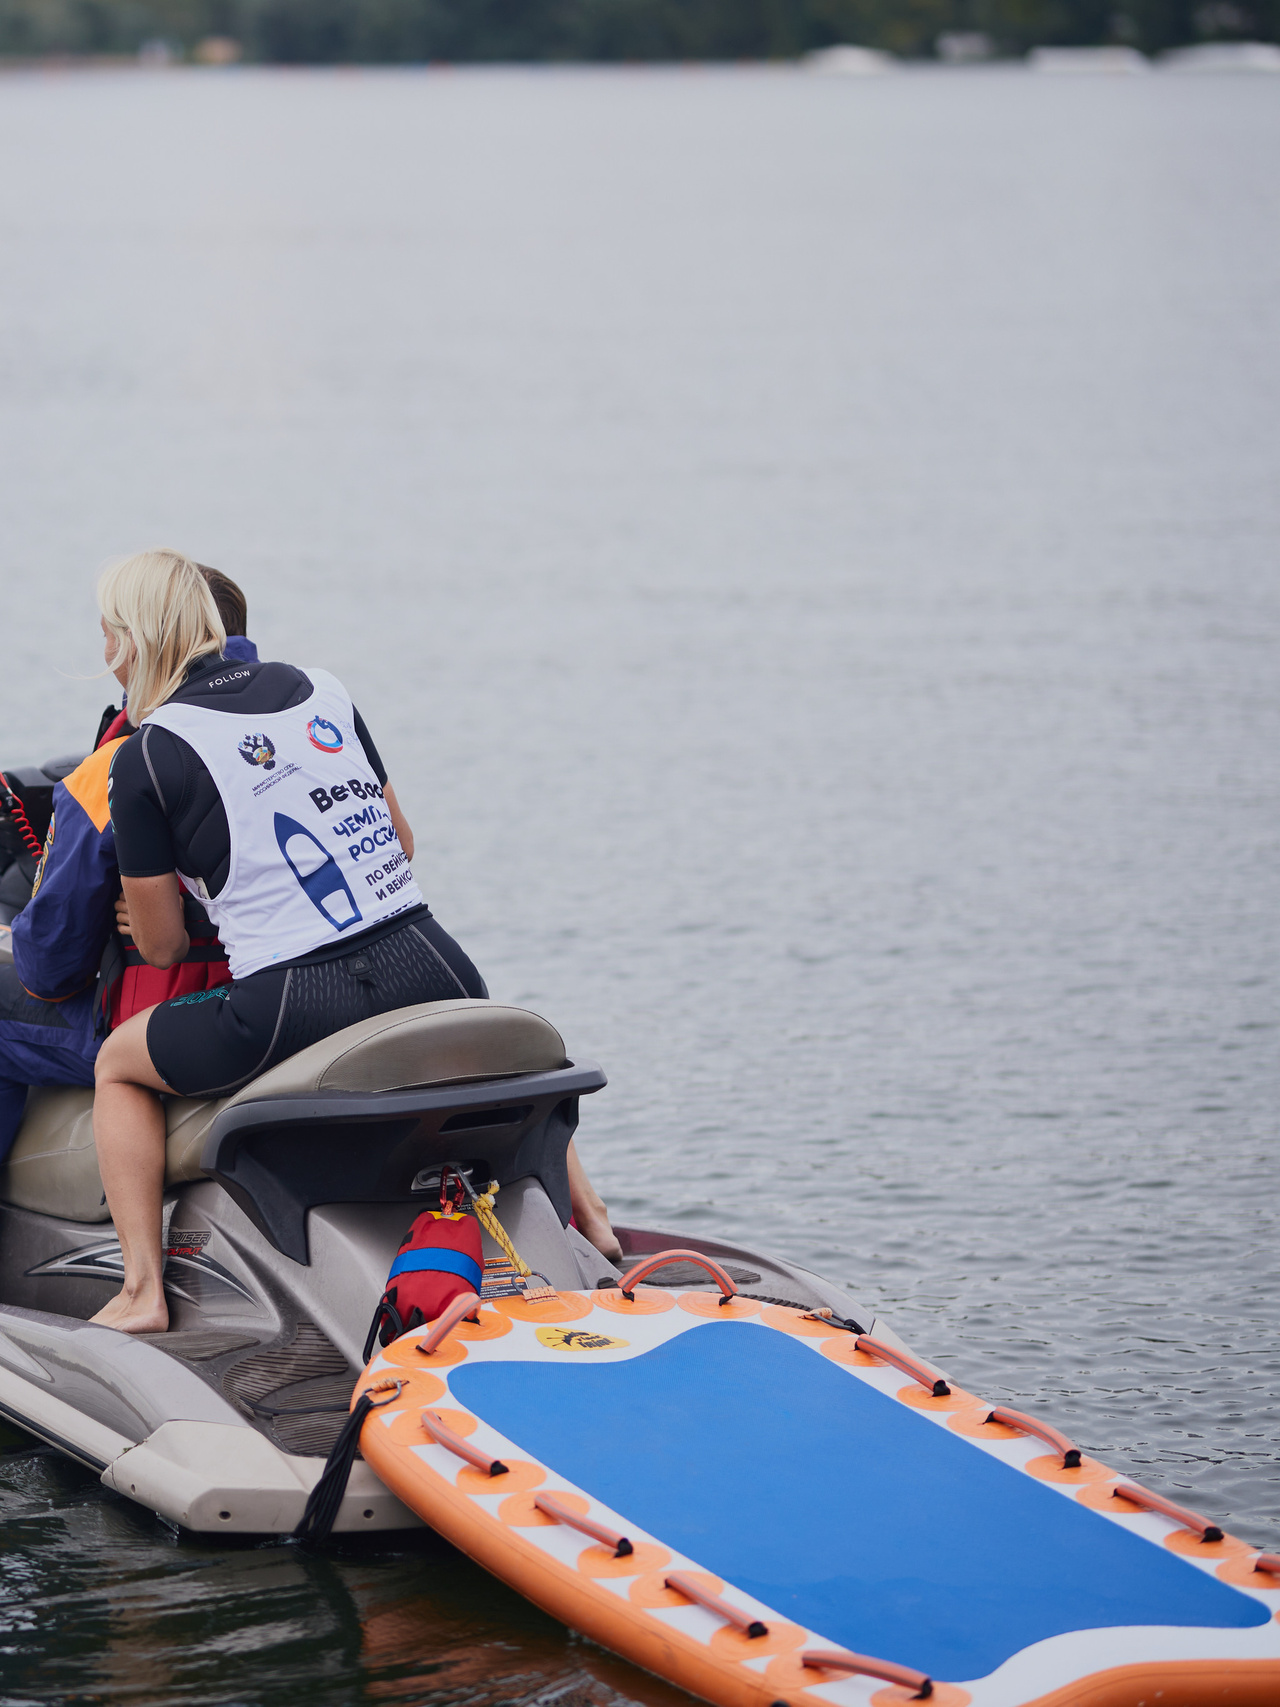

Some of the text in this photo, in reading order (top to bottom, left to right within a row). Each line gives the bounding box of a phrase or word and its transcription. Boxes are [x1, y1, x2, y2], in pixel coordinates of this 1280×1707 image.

[208, 670, 251, 689] FOLLOW
[332, 804, 388, 838] ЧЕМП
[365, 869, 384, 886] ПО
[375, 868, 413, 901] И ВЕЙКС
[168, 1231, 211, 1246] RUISER
[167, 1247, 202, 1256] OUTPUT
